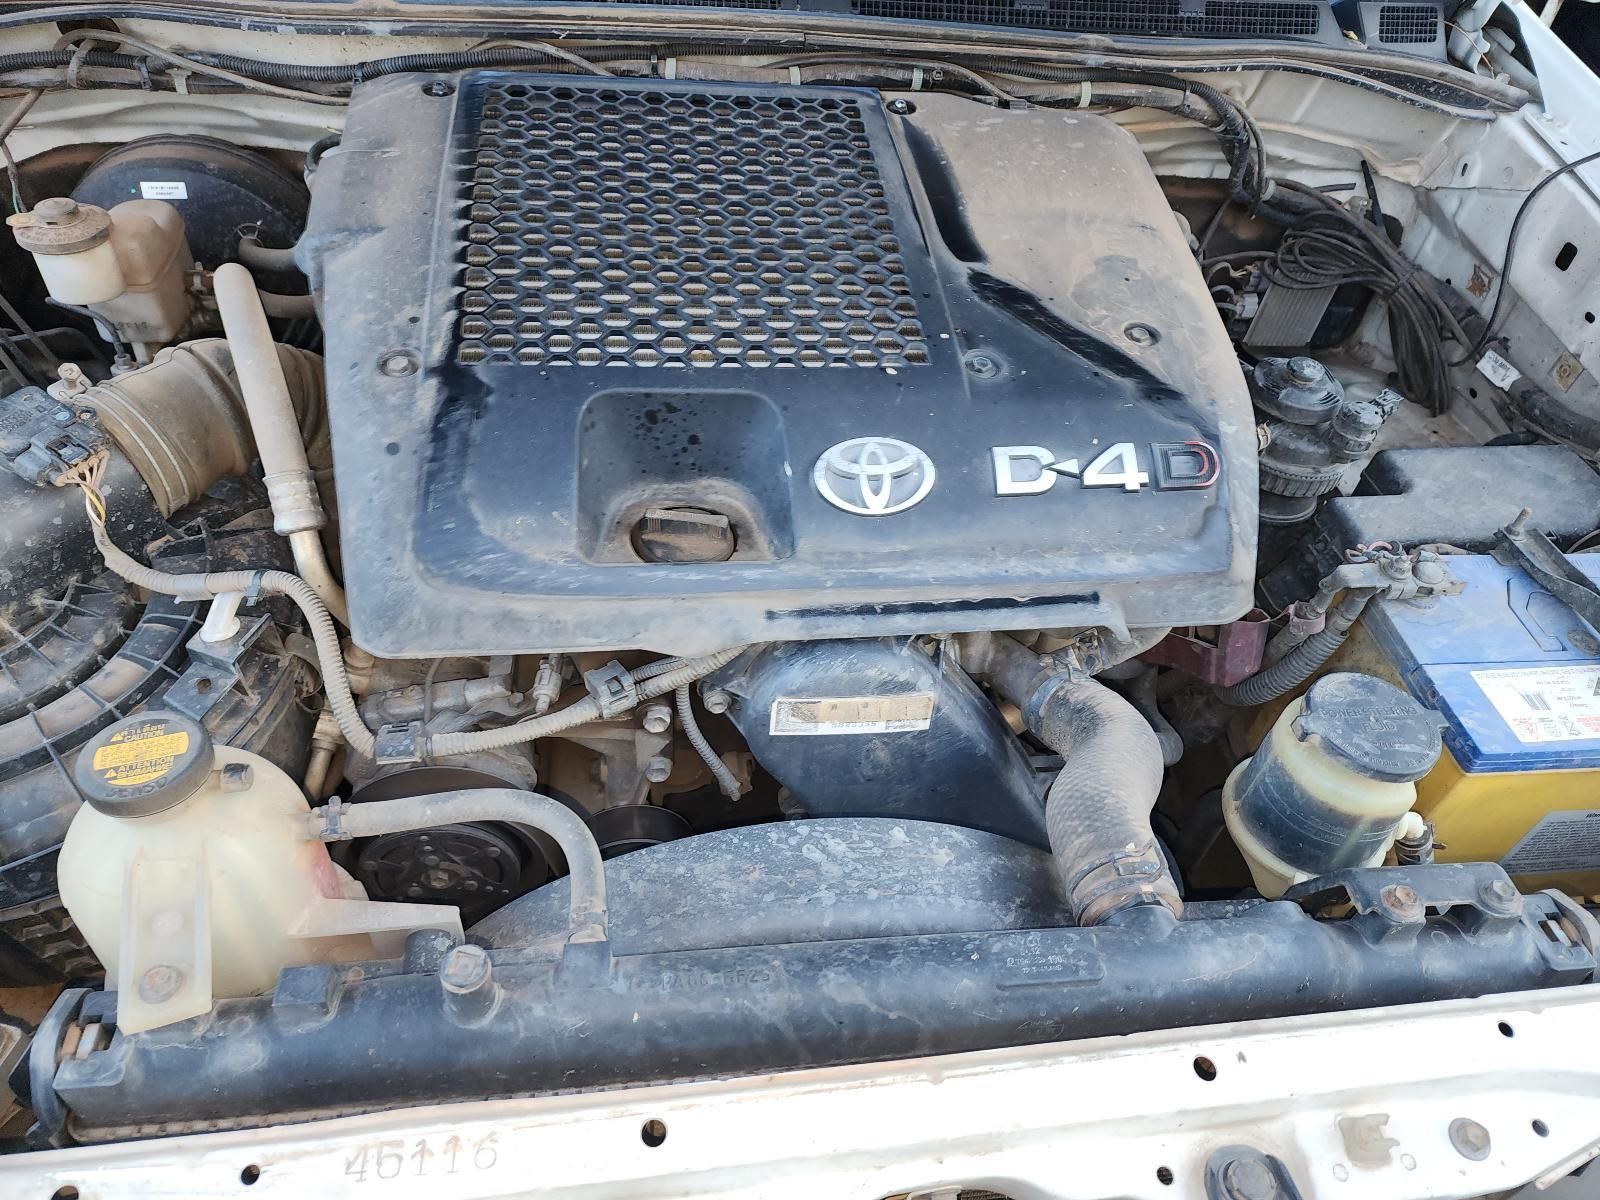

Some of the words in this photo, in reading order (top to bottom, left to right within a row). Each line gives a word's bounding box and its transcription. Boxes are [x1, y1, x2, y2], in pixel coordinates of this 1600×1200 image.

[1319, 708, 1362, 719] POWER
[1363, 705, 1418, 717] STEERING
[1361, 719, 1398, 732] FLUID
[123, 729, 165, 743] CAUTION
[118, 755, 175, 773] ATTENTION
